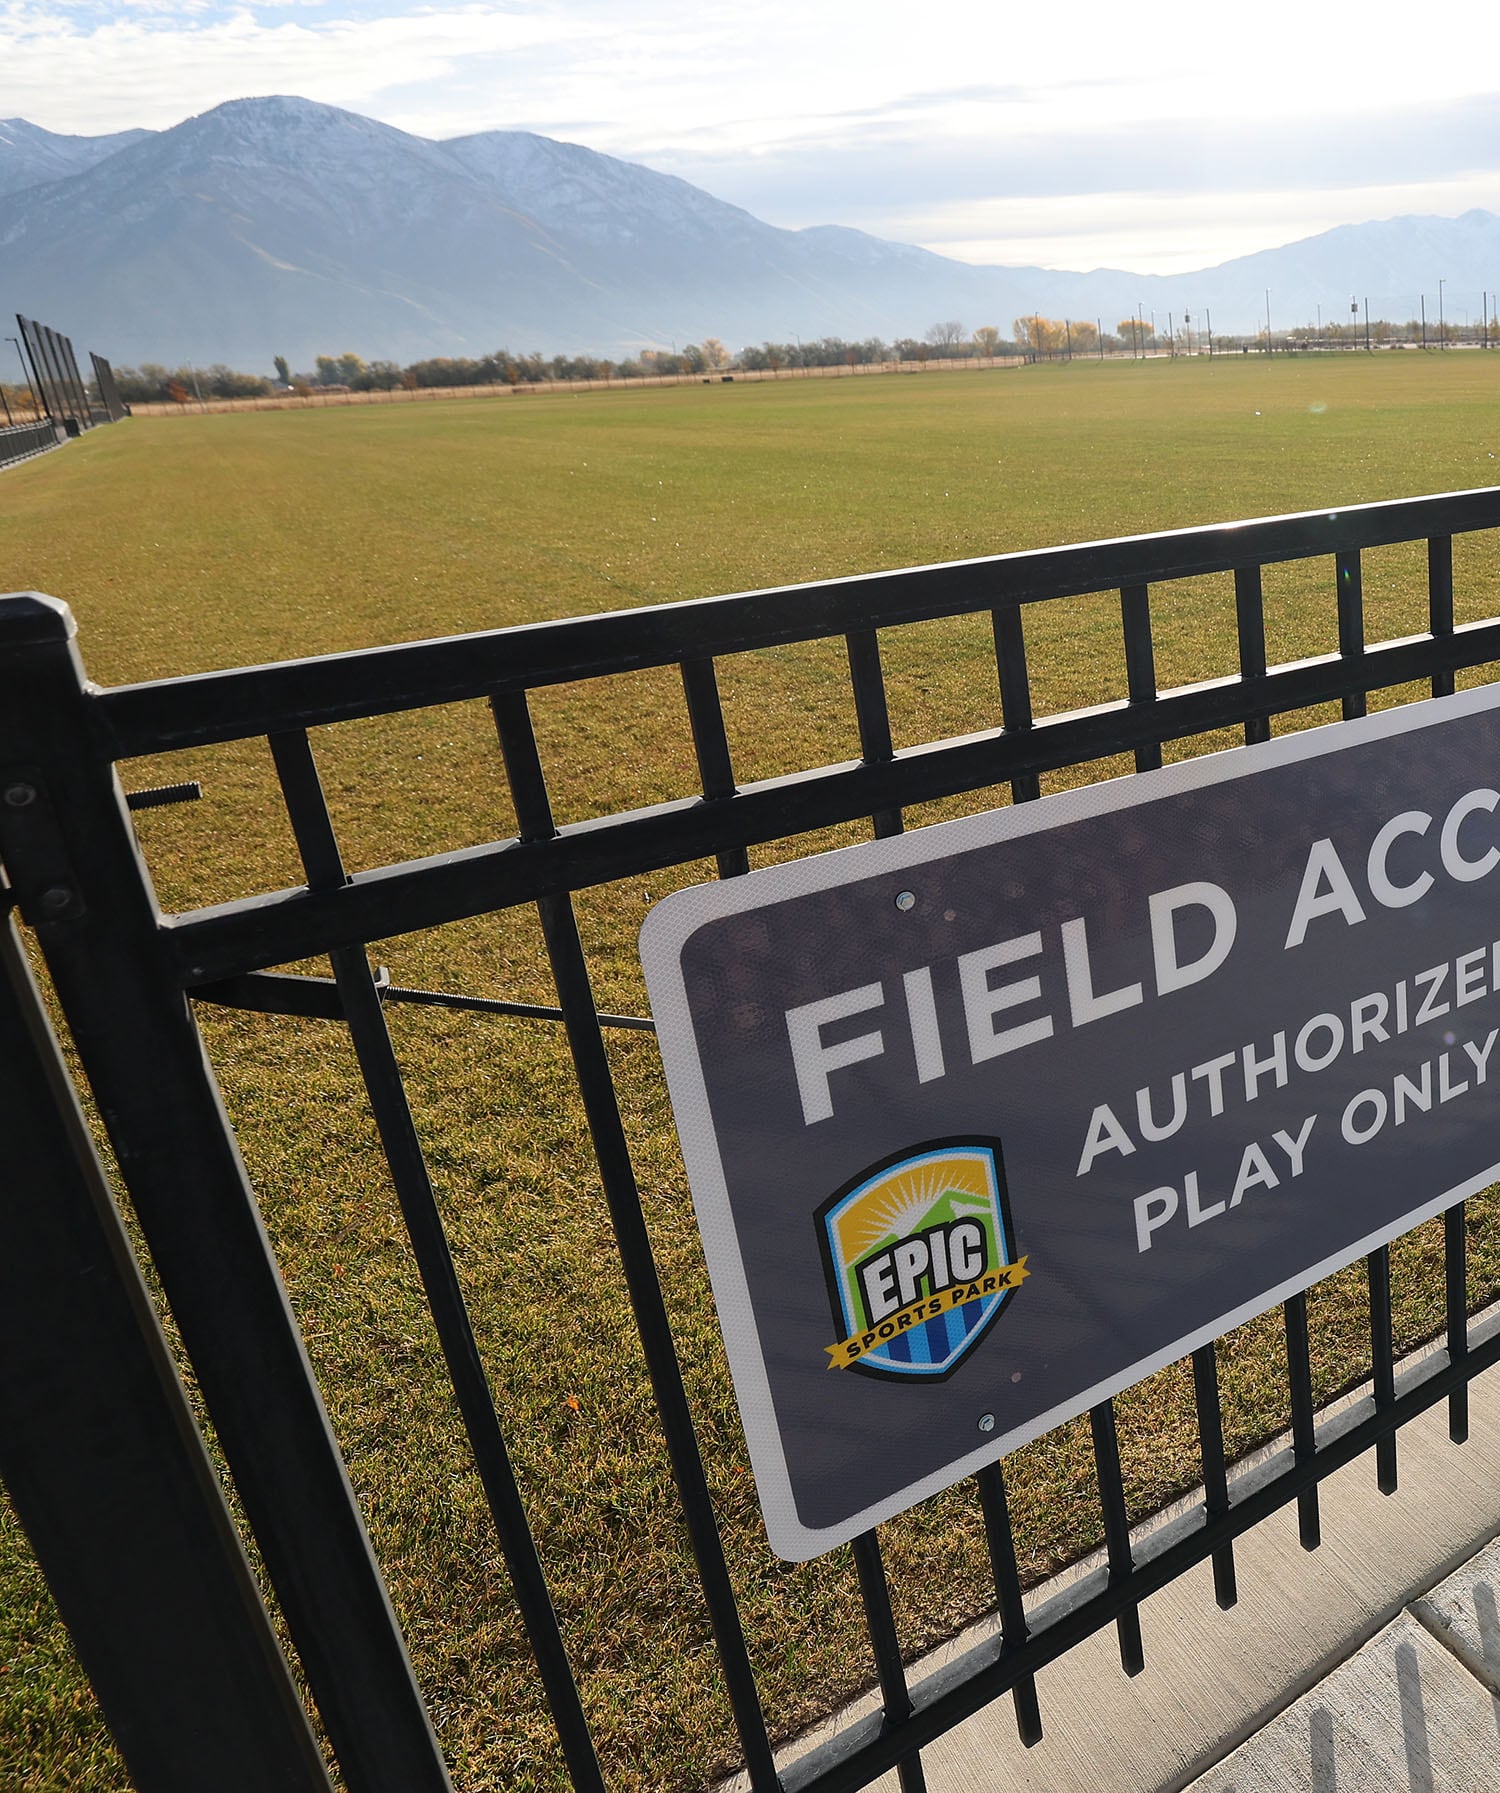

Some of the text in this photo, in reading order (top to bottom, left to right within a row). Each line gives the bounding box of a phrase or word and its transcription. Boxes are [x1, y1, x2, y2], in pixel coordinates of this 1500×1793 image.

[786, 881, 1238, 1125] FIELD
[1134, 1028, 1500, 1252] PLAY ONLY
[846, 1271, 1013, 1358] SPORTS PARK
[861, 1223, 983, 1325] EPIC
